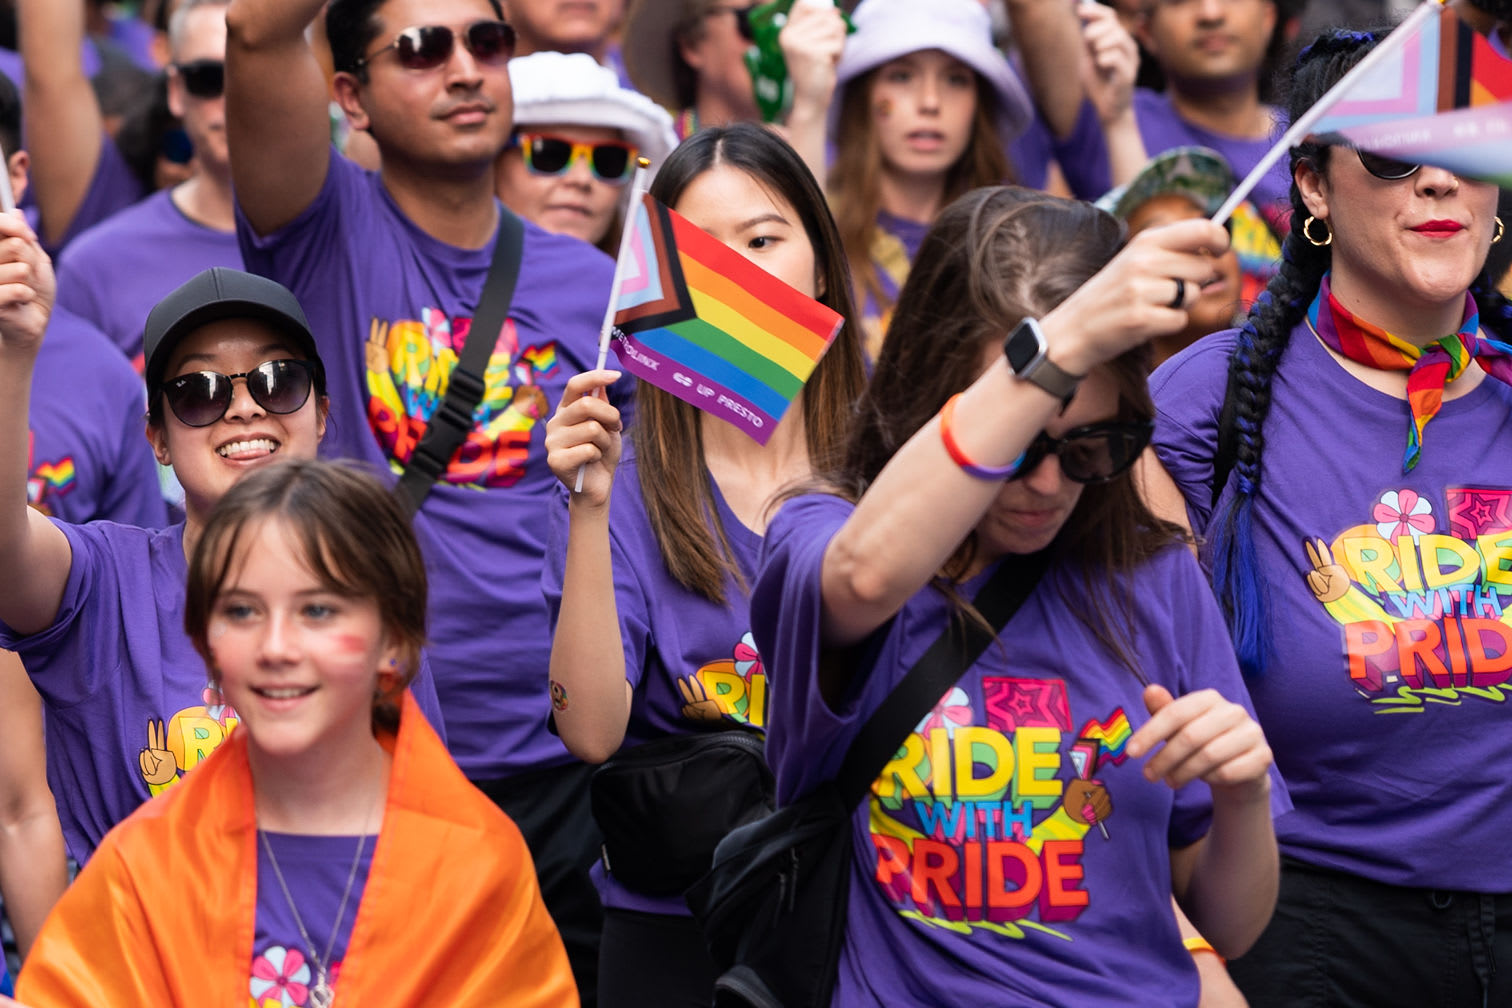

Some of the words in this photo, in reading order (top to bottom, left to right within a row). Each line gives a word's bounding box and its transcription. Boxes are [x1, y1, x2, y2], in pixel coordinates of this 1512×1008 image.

[369, 395, 531, 482] PRDE
[695, 382, 716, 398] UP
[715, 393, 765, 429] PRESTO
[1389, 583, 1504, 621] WITH
[1344, 614, 1512, 689] PRID
[703, 670, 766, 728] RI
[876, 726, 1064, 802] RIDE
[914, 800, 1034, 842] WITH
[870, 833, 1090, 919] PRIDE
